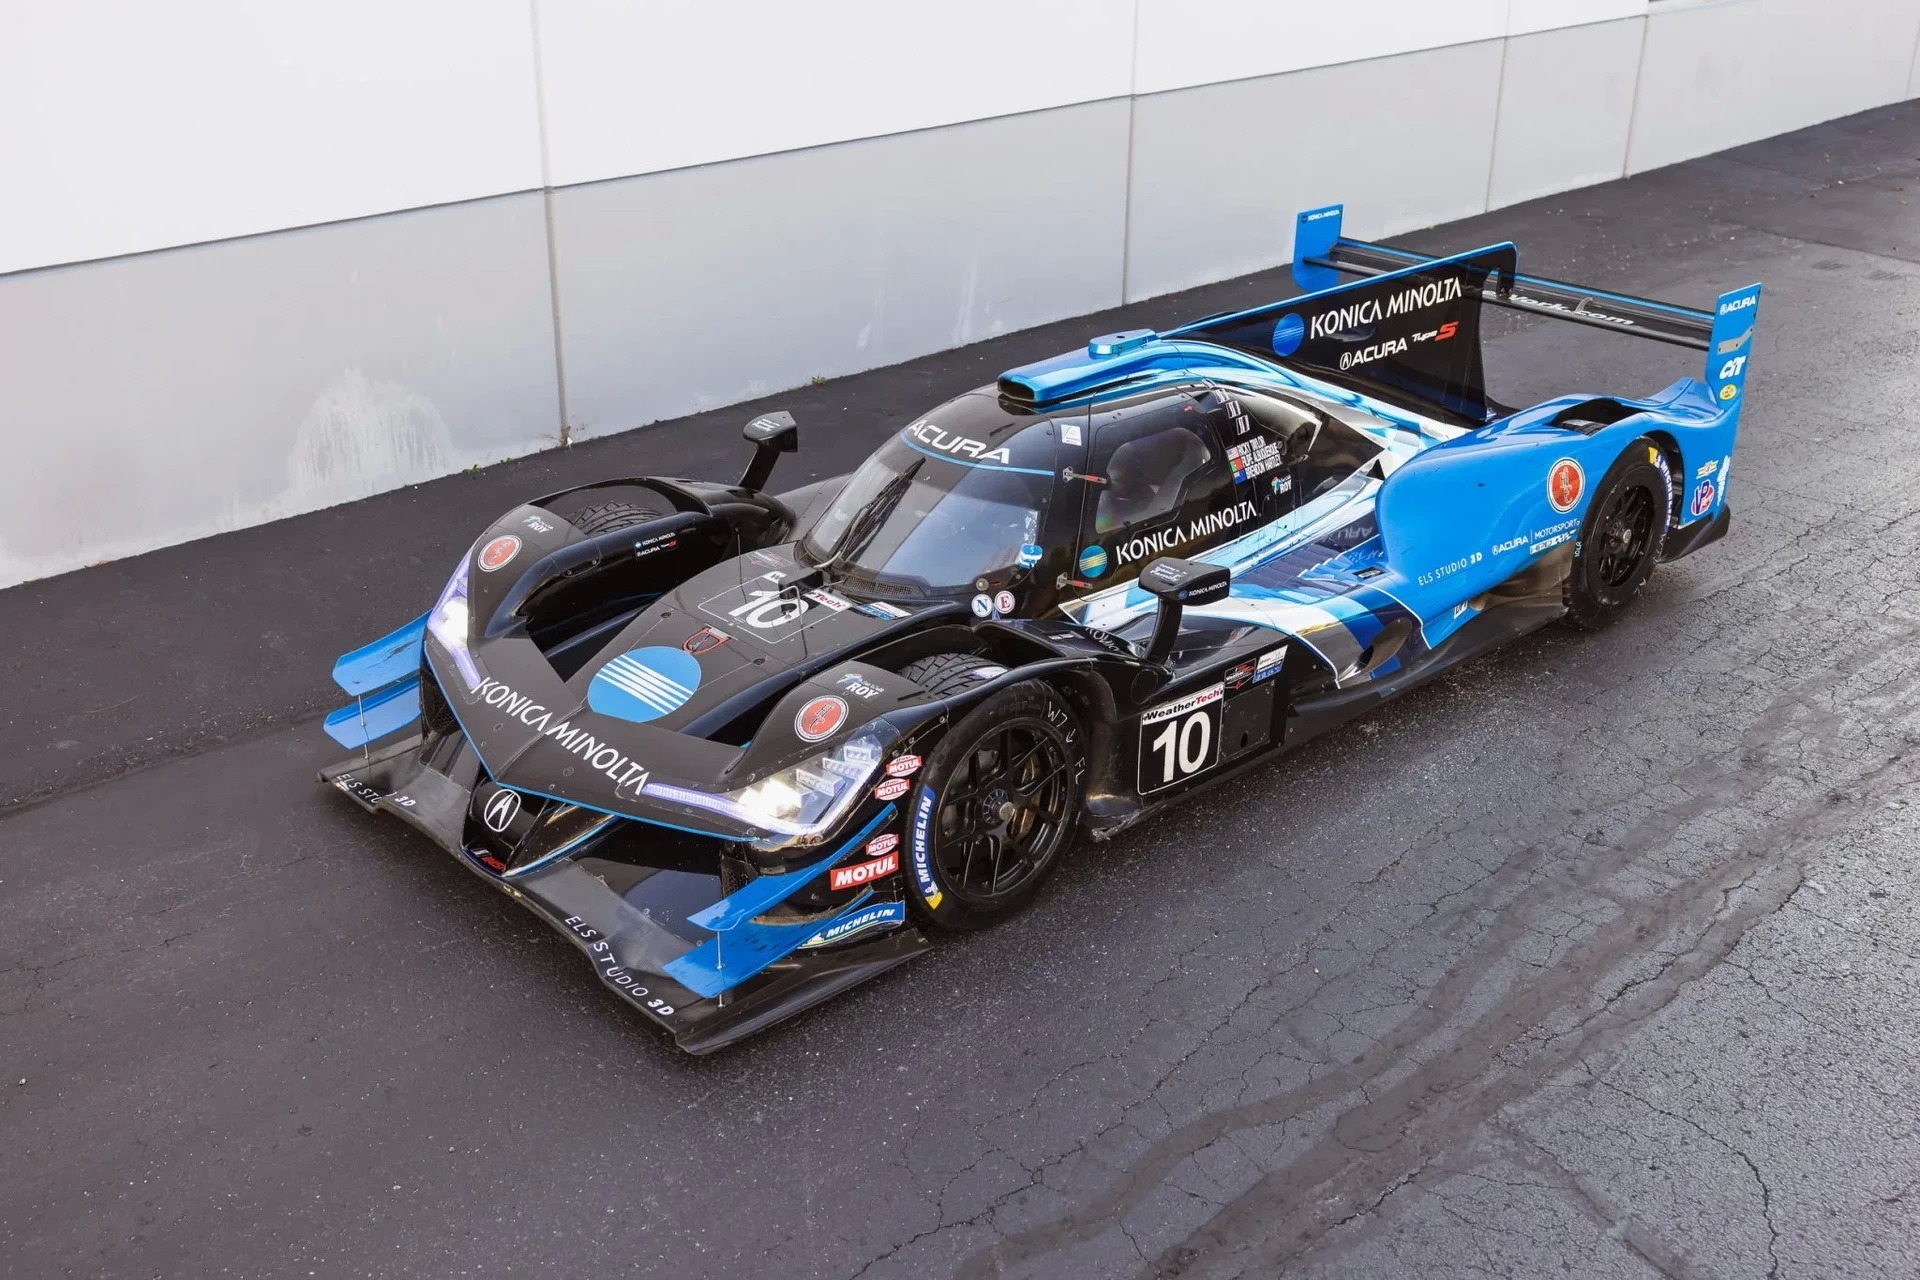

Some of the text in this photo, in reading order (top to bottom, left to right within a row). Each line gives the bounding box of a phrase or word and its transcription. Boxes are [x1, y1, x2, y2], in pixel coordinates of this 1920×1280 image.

[1310, 276, 1462, 340] KONICA MINOLTA
[1725, 295, 1756, 314] ACURA
[1351, 337, 1408, 367] ACURA
[908, 419, 1010, 464] ACURA
[1116, 500, 1258, 565] KONICA MINOLTA
[1498, 536, 1529, 553] ACURA
[1417, 552, 1483, 586] ELS STUDIO 3D
[728, 590, 809, 628] 10
[845, 682, 880, 699] ROY
[1146, 689, 1220, 720] WeatherTech
[471, 677, 651, 796] KONICA MINOLTA
[1153, 711, 1211, 783] 10
[888, 758, 921, 772] MOTUL
[876, 781, 909, 797] MOTUL
[868, 836, 898, 853] MOTUL
[915, 796, 932, 883] MICHELIN
[835, 856, 896, 886] MOTUL
[826, 909, 895, 938] MICHELIN
[564, 915, 675, 1016] ELS STUDIO 3D
